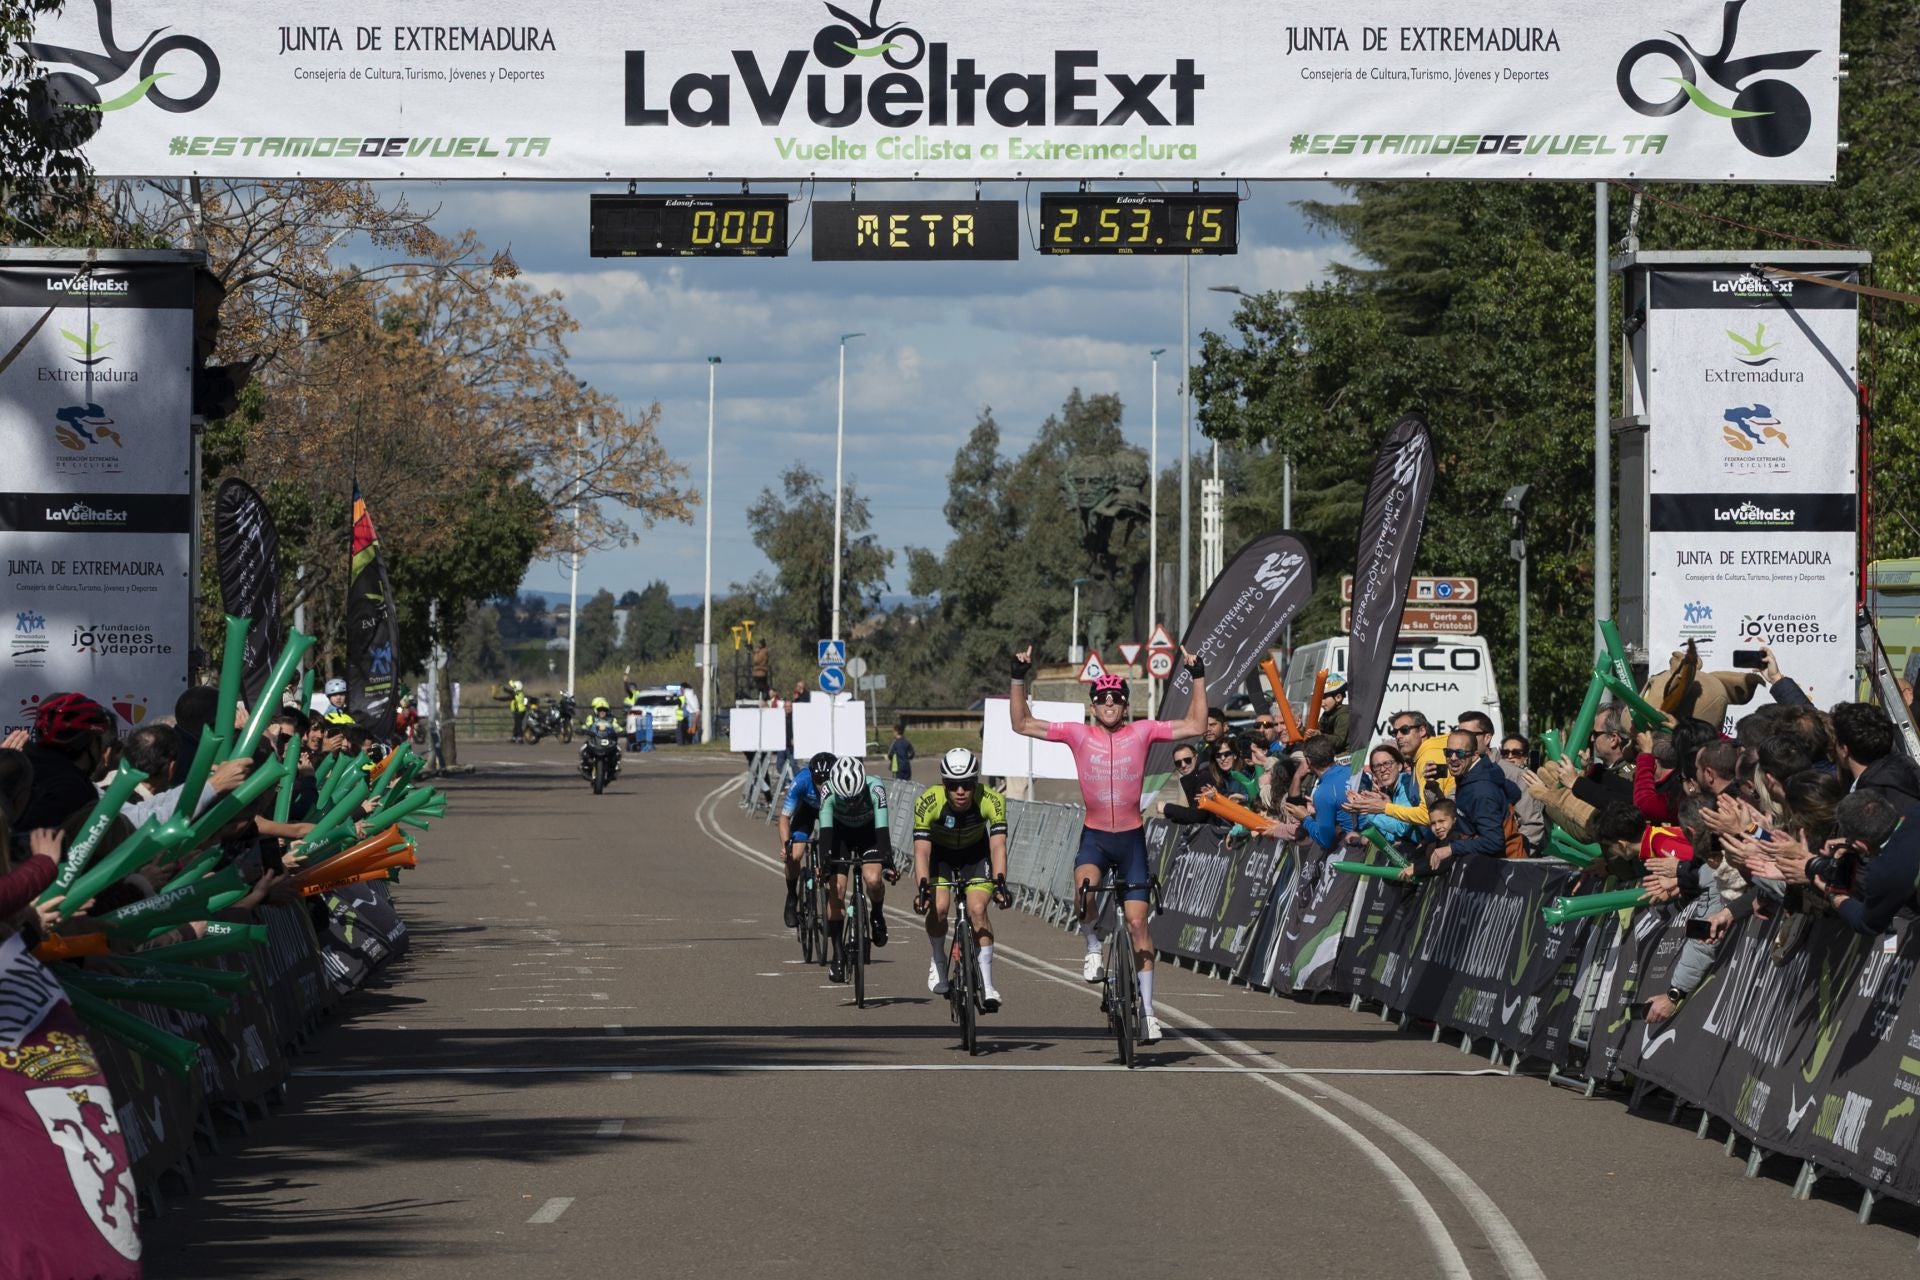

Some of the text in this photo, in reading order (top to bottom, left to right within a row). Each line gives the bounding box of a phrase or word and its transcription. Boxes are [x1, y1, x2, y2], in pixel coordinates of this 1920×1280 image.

[278, 26, 557, 55] JUNTA DE EXTREMADURA
[1285, 26, 1561, 55] JUNTA DE EXTREMADURA
[293, 66, 545, 84] Consejería de Cultura, Turismo, Jóvenes y Deportes
[1300, 67, 1550, 84] Consejería de Cultura, Turismo, Jóvenes y Deportes
[624, 41, 1206, 128] LaVueltaExt
[168, 136, 552, 158] #ESTAMOSDEVUELTA
[774, 135, 1198, 161] Vuelta Ciclista a Extremadura
[1288, 134, 1669, 156] #ESTAMOSDEVUELTA
[857, 213, 976, 248] META
[46, 276, 129, 292] LaVueltaExt
[37, 366, 139, 382] Extremadura
[1705, 367, 1804, 383] Extremadura
[45, 507, 128, 521] LaVueltaExt
[1714, 507, 1796, 521] LaVueltaExt
[1359, 490, 1405, 643] DE CICLISMO
[1676, 550, 1832, 567] JUNTA DE EXTREMADURA
[8, 559, 165, 577] JUNTA DE EXTREMADURA
[1716, 573, 1723, 581] de
[1799, 573, 1826, 583] Deportes
[131, 584, 158, 593] Deportes
[1353, 559, 1380, 638] FEDERACIÓN
[1214, 585, 1257, 635] EXTREMEÑA
[1430, 612, 1472, 621] Fuerte de
[1767, 613, 1816, 621] fundación
[101, 623, 150, 632] fundación
[1202, 591, 1264, 667] CICLISMO
[1767, 634, 1838, 645] ydeporte
[101, 644, 172, 656] ydeporte
[1222, 603, 1296, 696] www.ciclismoextremadura.es
[1151, 659, 1168, 669] 20
[1337, 648, 1481, 672] IECO
[1385, 682, 1460, 692] MANCHA
[56, 814, 110, 888] LaVueltaExt
